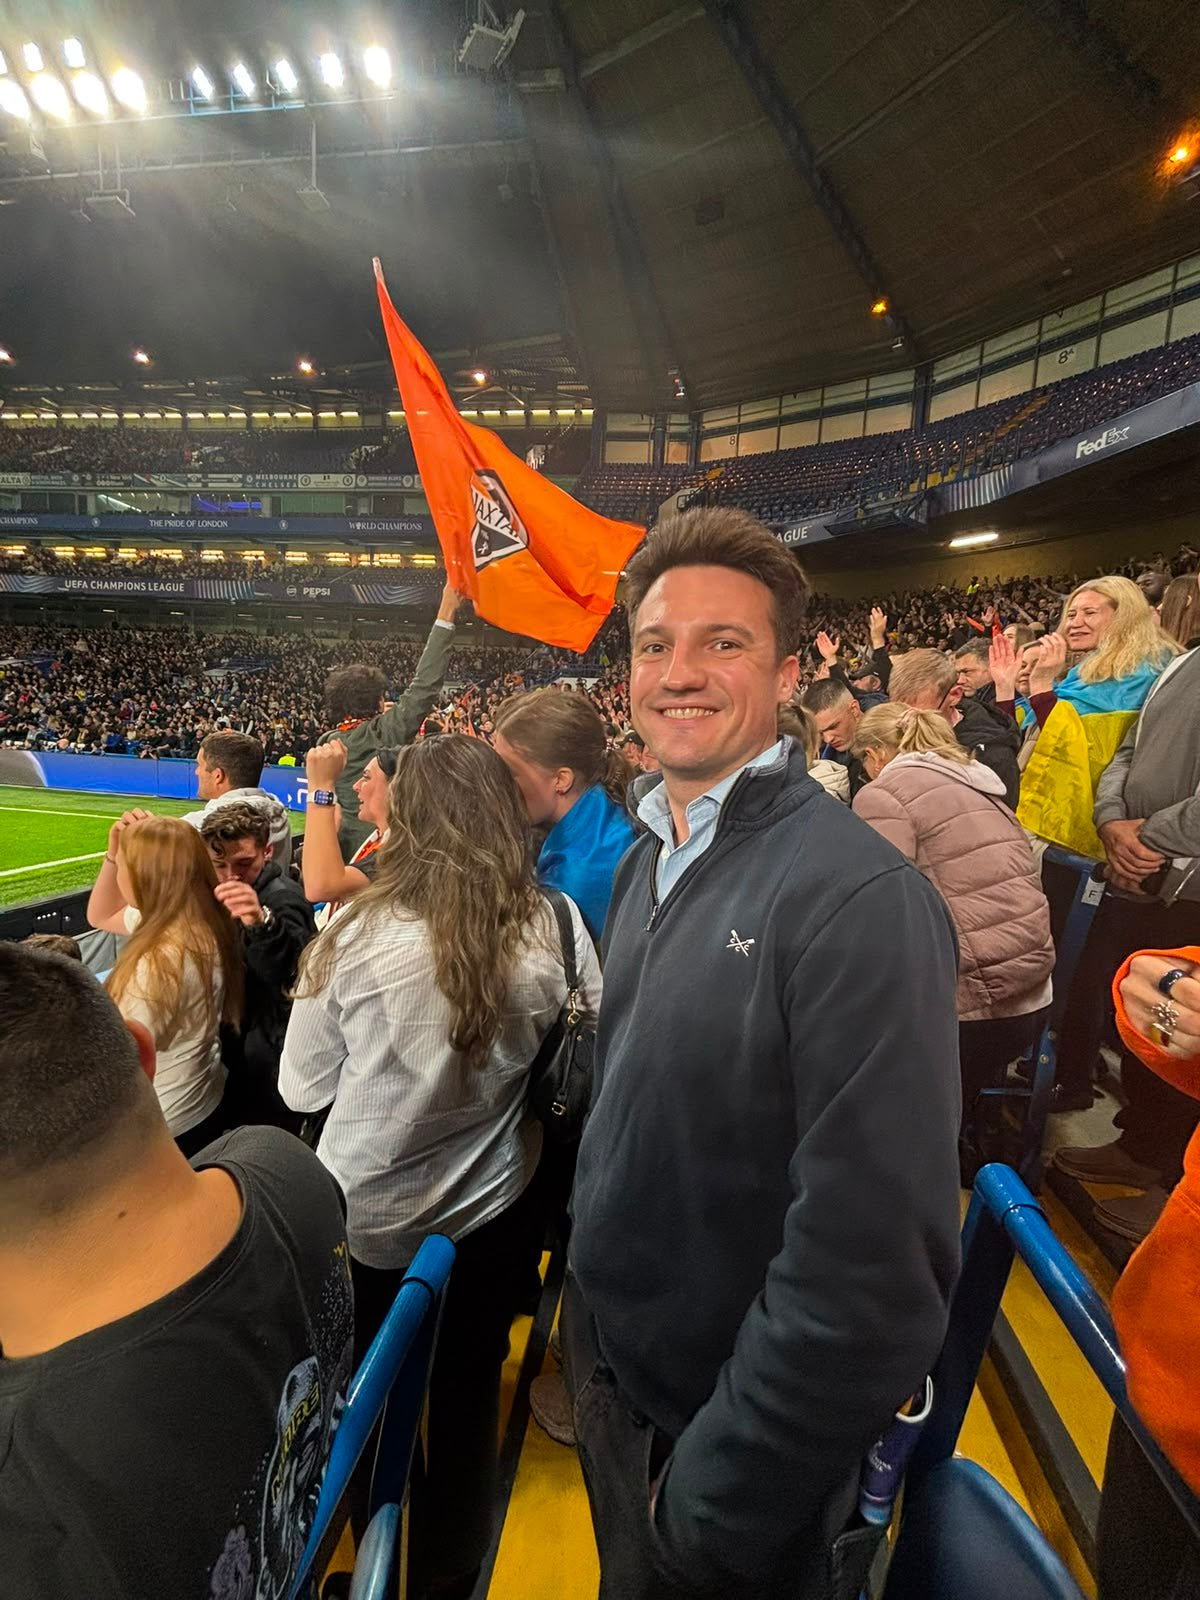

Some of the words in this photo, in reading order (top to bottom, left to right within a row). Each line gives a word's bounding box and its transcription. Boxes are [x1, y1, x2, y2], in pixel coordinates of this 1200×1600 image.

[729, 435, 736, 445] 8
[1075, 426, 1130, 459] FedEx
[149, 519, 163, 528] THE
[164, 519, 185, 528] PRIDE
[186, 519, 196, 528] OF
[197, 519, 229, 528] LONDON
[377, 521, 422, 531] CHAMPIONS
[776, 526, 809, 543] AGUE
[65, 579, 88, 589] UEFA
[90, 580, 146, 591] CHAMPIONS
[148, 582, 185, 592] LEAGUE
[303, 587, 330, 596] PEPSI
[1088, 889, 1097, 898] F
